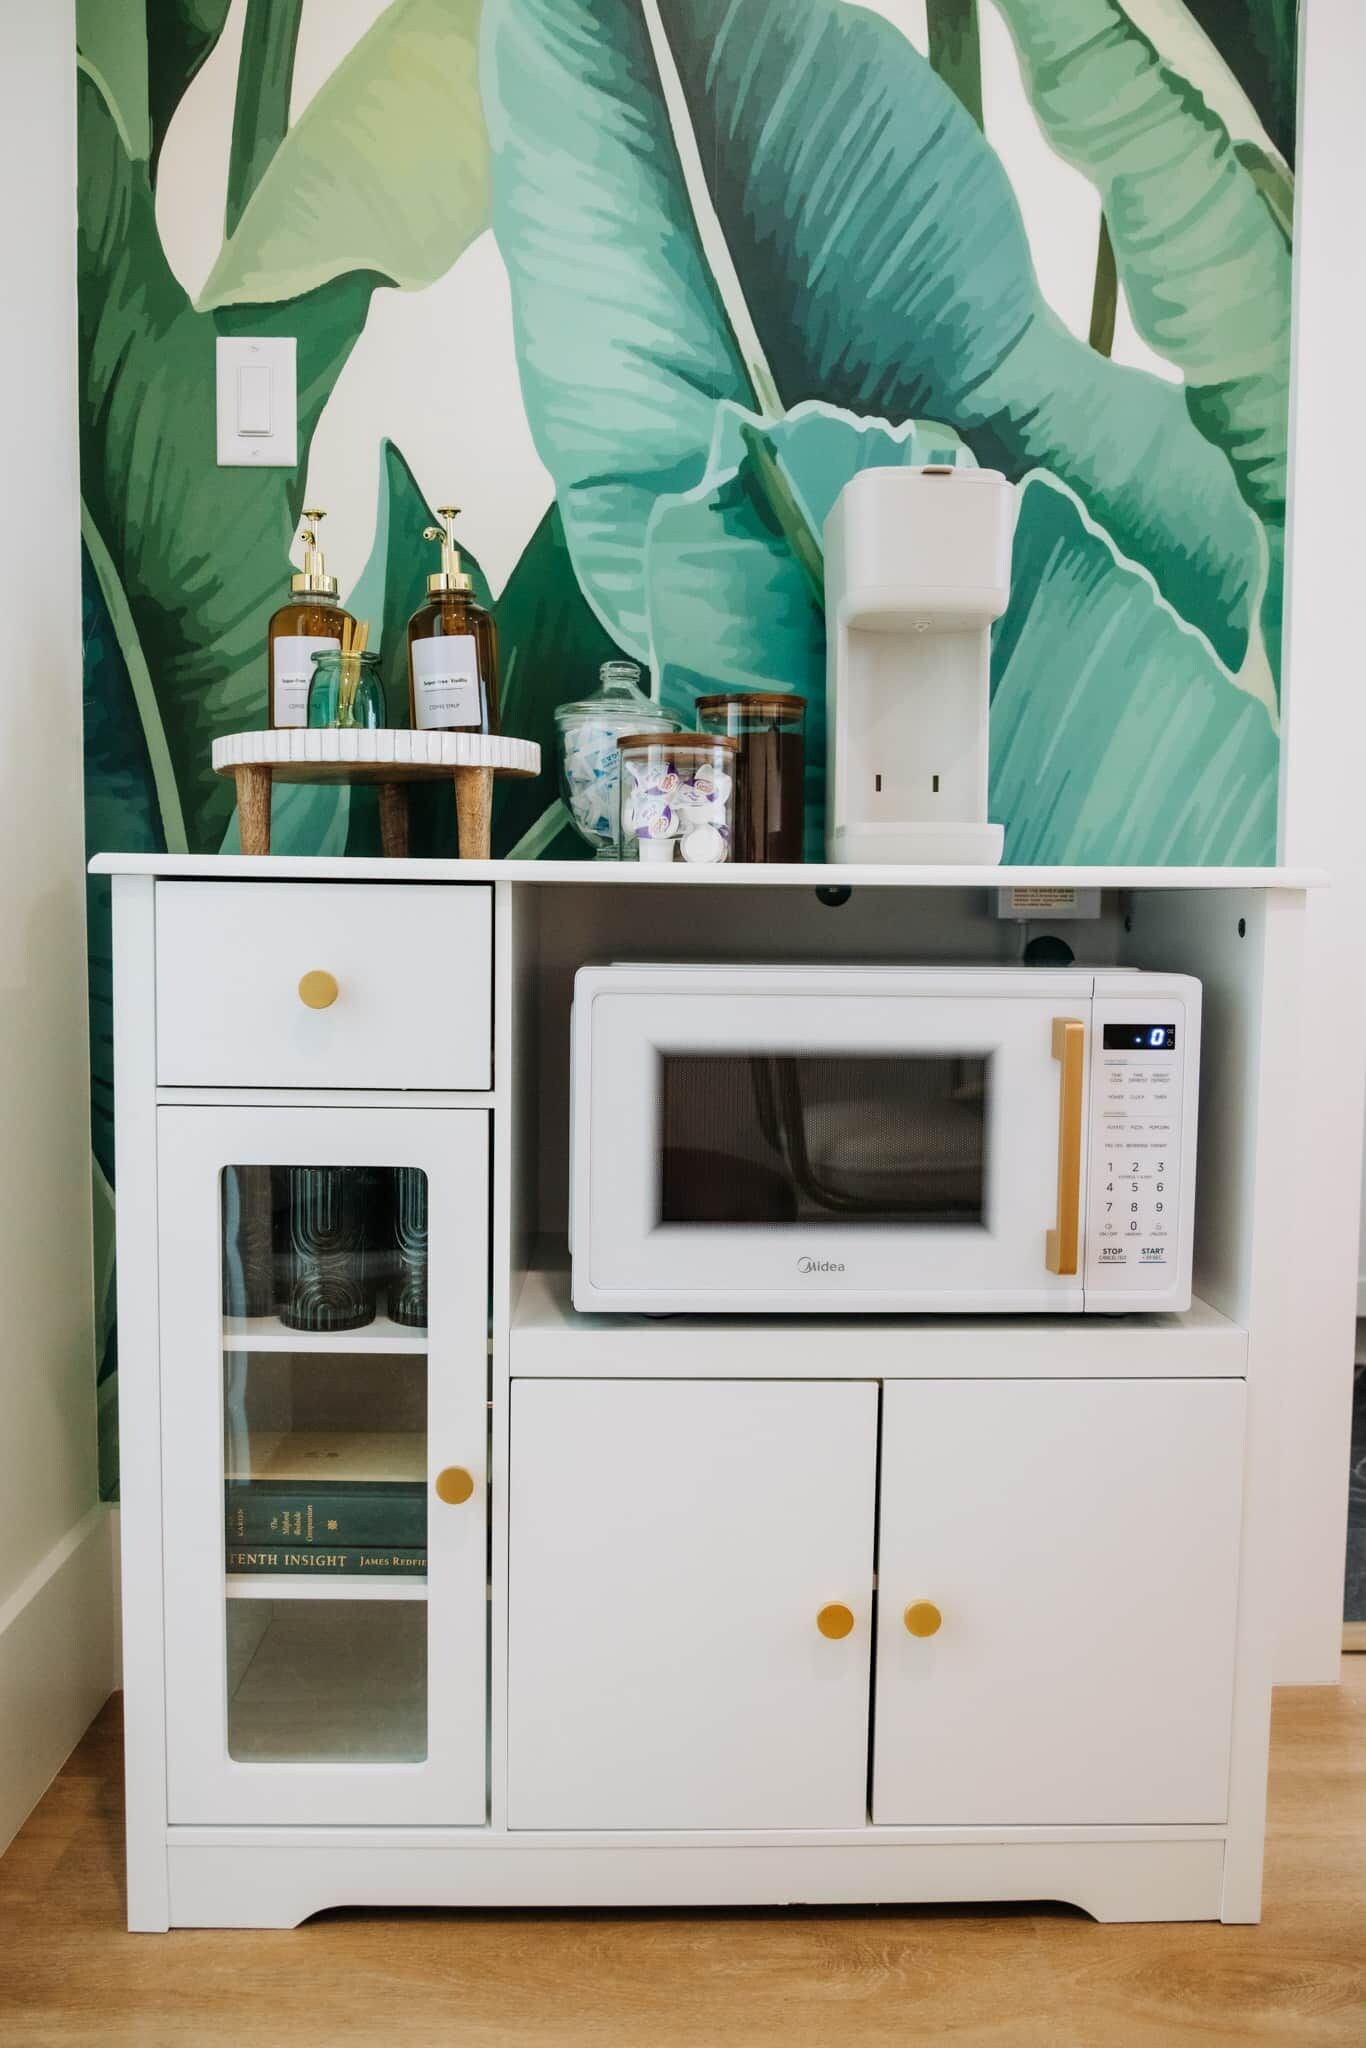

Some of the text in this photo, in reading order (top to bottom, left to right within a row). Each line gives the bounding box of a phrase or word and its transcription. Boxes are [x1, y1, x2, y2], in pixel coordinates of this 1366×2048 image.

[1151, 1028, 1165, 1046] 0
[1107, 1162, 1112, 1172] 1
[1132, 1162, 1140, 1172] 2
[1157, 1162, 1164, 1172] 3
[1106, 1182, 1113, 1192] 4
[1131, 1182, 1138, 1192] 5
[1156, 1182, 1164, 1192] 6
[1105, 1202, 1113, 1212] 7
[1130, 1202, 1138, 1212] 8
[1155, 1202, 1163, 1212] 9
[1130, 1220, 1137, 1231] 0
[1103, 1247, 1123, 1255] STOP
[1142, 1247, 1164, 1255] START
[797, 1256, 845, 1273] Midea
[284, 1553, 347, 1568] INSIGHT
